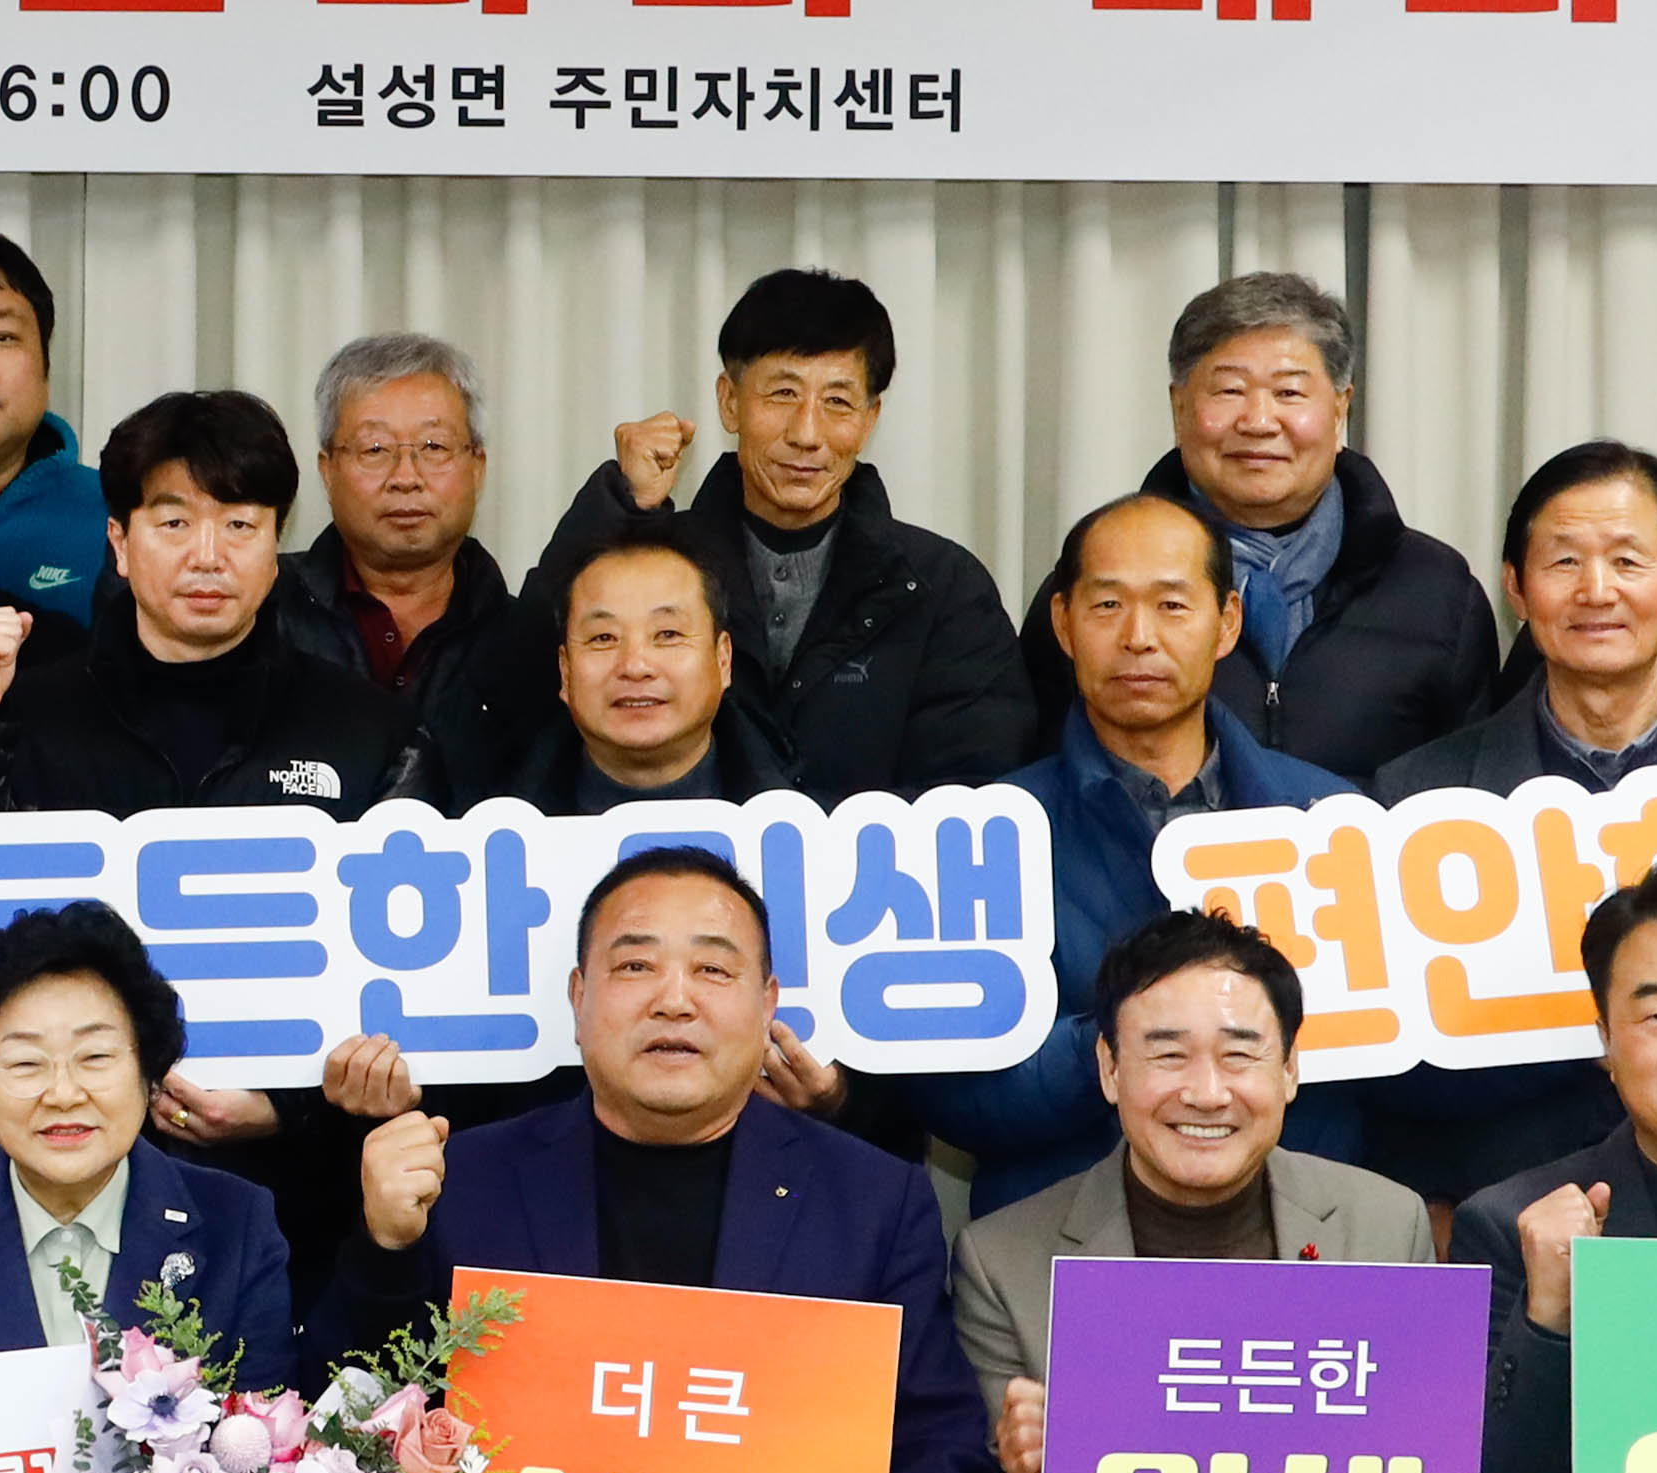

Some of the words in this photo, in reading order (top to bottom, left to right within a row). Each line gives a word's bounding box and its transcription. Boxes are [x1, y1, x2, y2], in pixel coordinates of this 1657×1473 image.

[306, 63, 506, 129] 설성면
[549, 66, 964, 133] 주민자치센터
[268, 769, 318, 784] NORTH
[289, 759, 318, 773] THE
[282, 781, 318, 796] FACE
[1158, 1338, 1377, 1415] 든든한
[590, 1360, 655, 1438] 더
[677, 1367, 751, 1445] 큰
